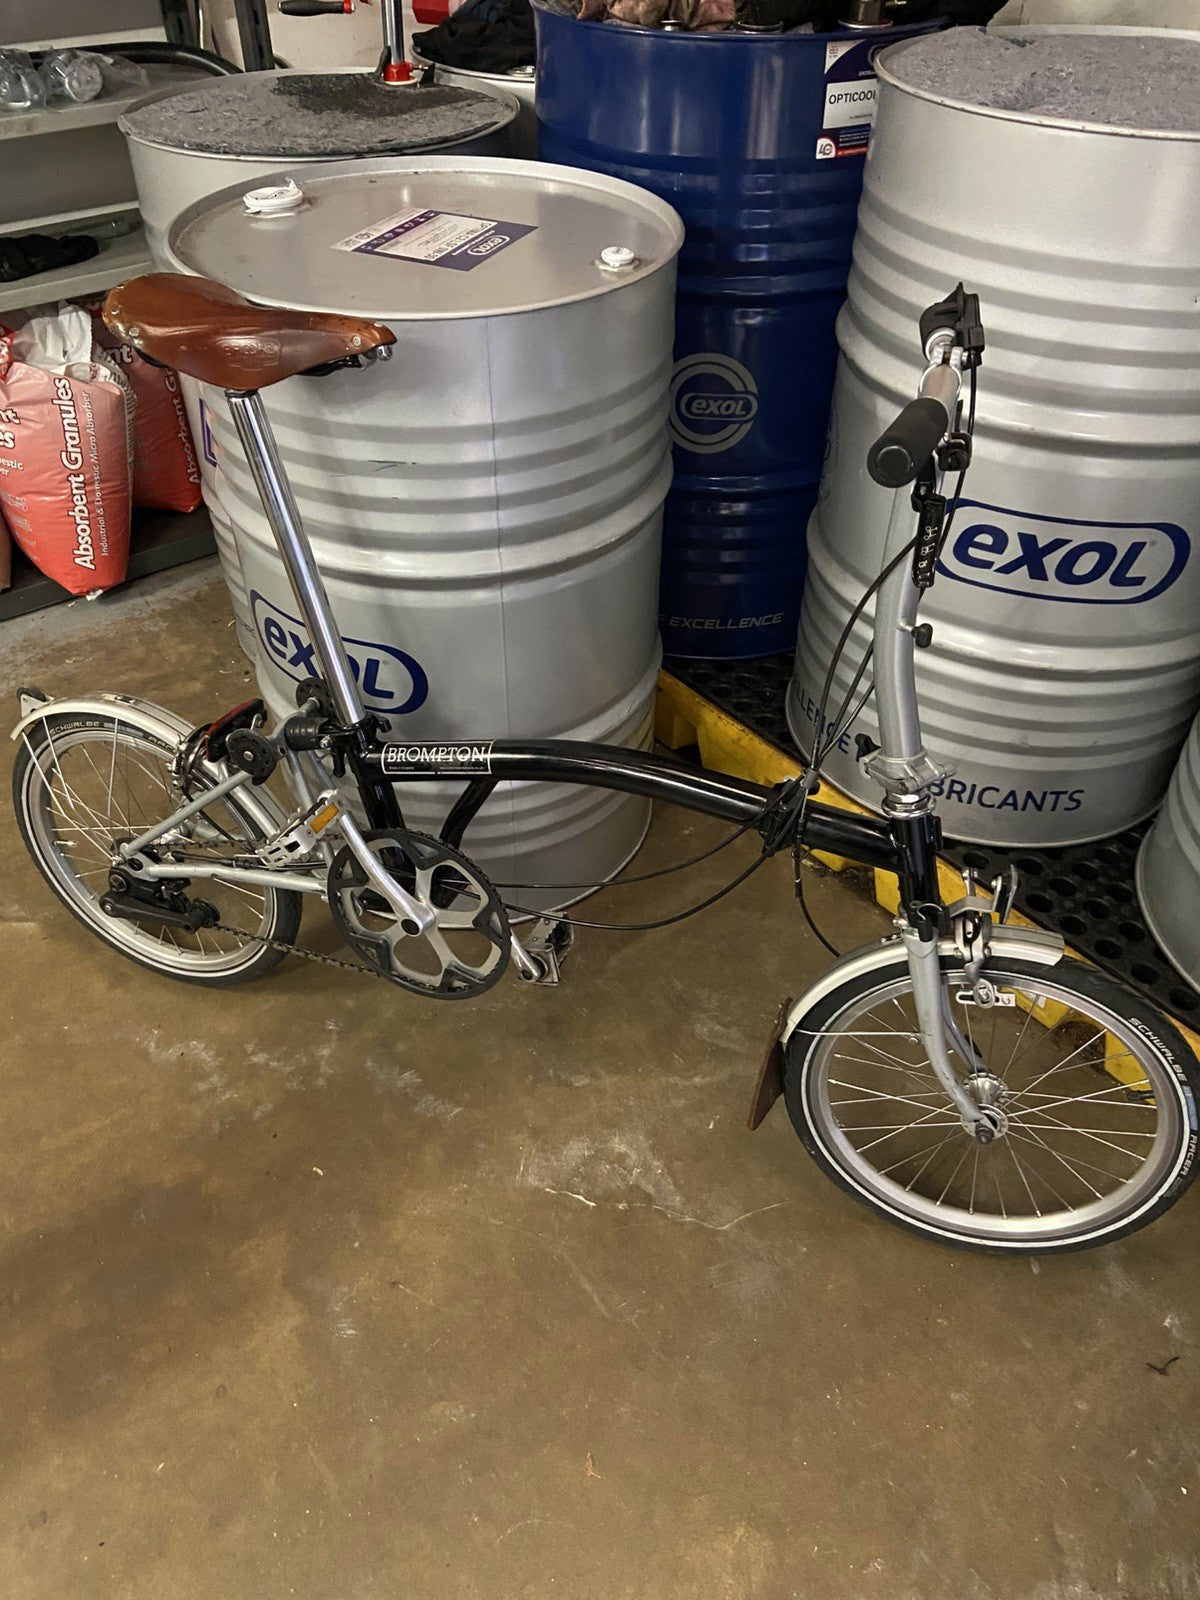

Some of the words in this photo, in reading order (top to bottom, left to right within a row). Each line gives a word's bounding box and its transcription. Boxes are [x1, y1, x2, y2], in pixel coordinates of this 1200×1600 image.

[52, 378, 83, 471] Granules
[82, 390, 96, 435] Absorber
[90, 434, 99, 464] Micro
[93, 464, 103, 505] Domestic
[67, 473, 97, 570] Absorbent
[96, 507, 104, 515] &
[97, 516, 109, 556] Industrial
[669, 612, 784, 630] EXCELLENCE
[50, 720, 100, 736] SCHWALBE
[386, 746, 486, 763] BROMPTON
[1128, 1017, 1188, 1082] SCHWALBE
[1181, 1134, 1198, 1176] RACER
